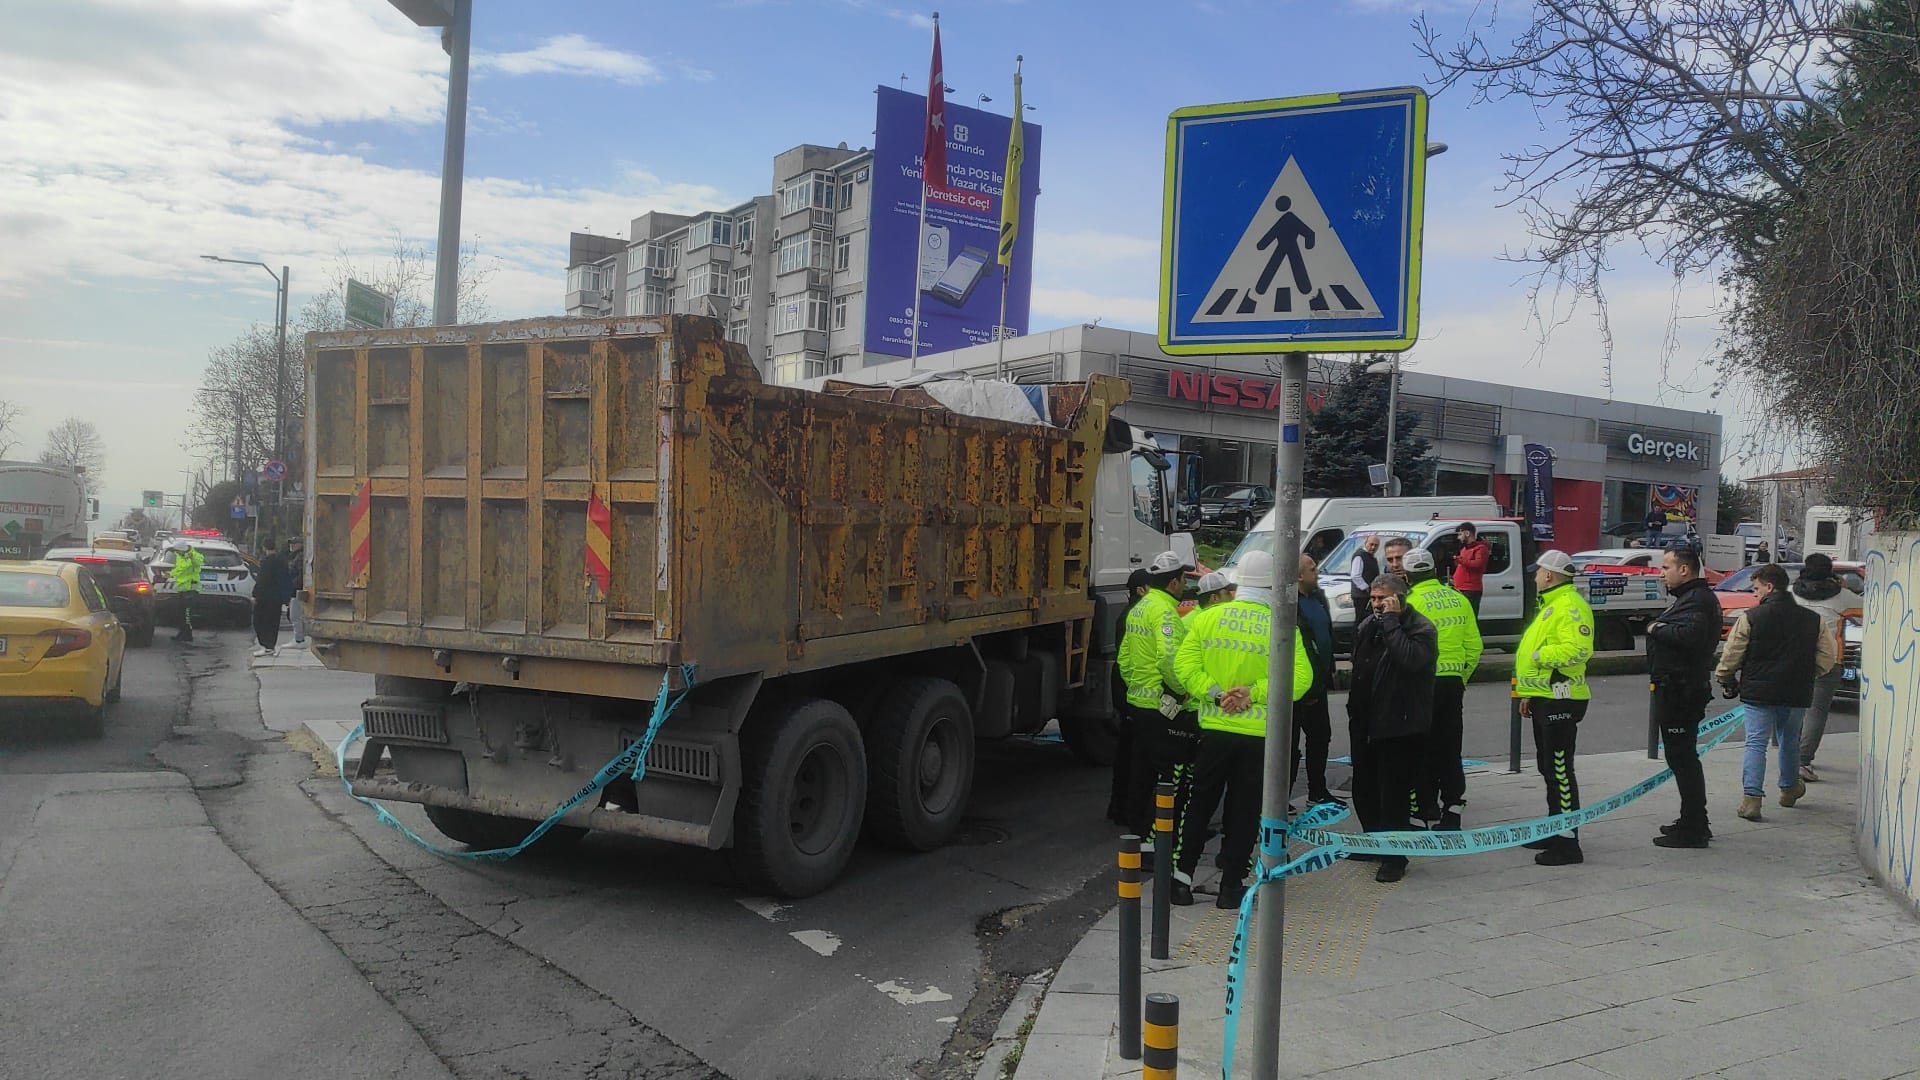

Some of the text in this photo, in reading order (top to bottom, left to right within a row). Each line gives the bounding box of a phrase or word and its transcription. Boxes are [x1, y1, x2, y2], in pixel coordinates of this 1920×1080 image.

[901, 165, 923, 179] Yeni
[952, 176, 977, 191] Yazar
[969, 168, 1003, 184] POS ile
[926, 184, 966, 204] Ücretsiz
[968, 196, 990, 211] Geç!
[1627, 433, 1700, 462] Gerçek
